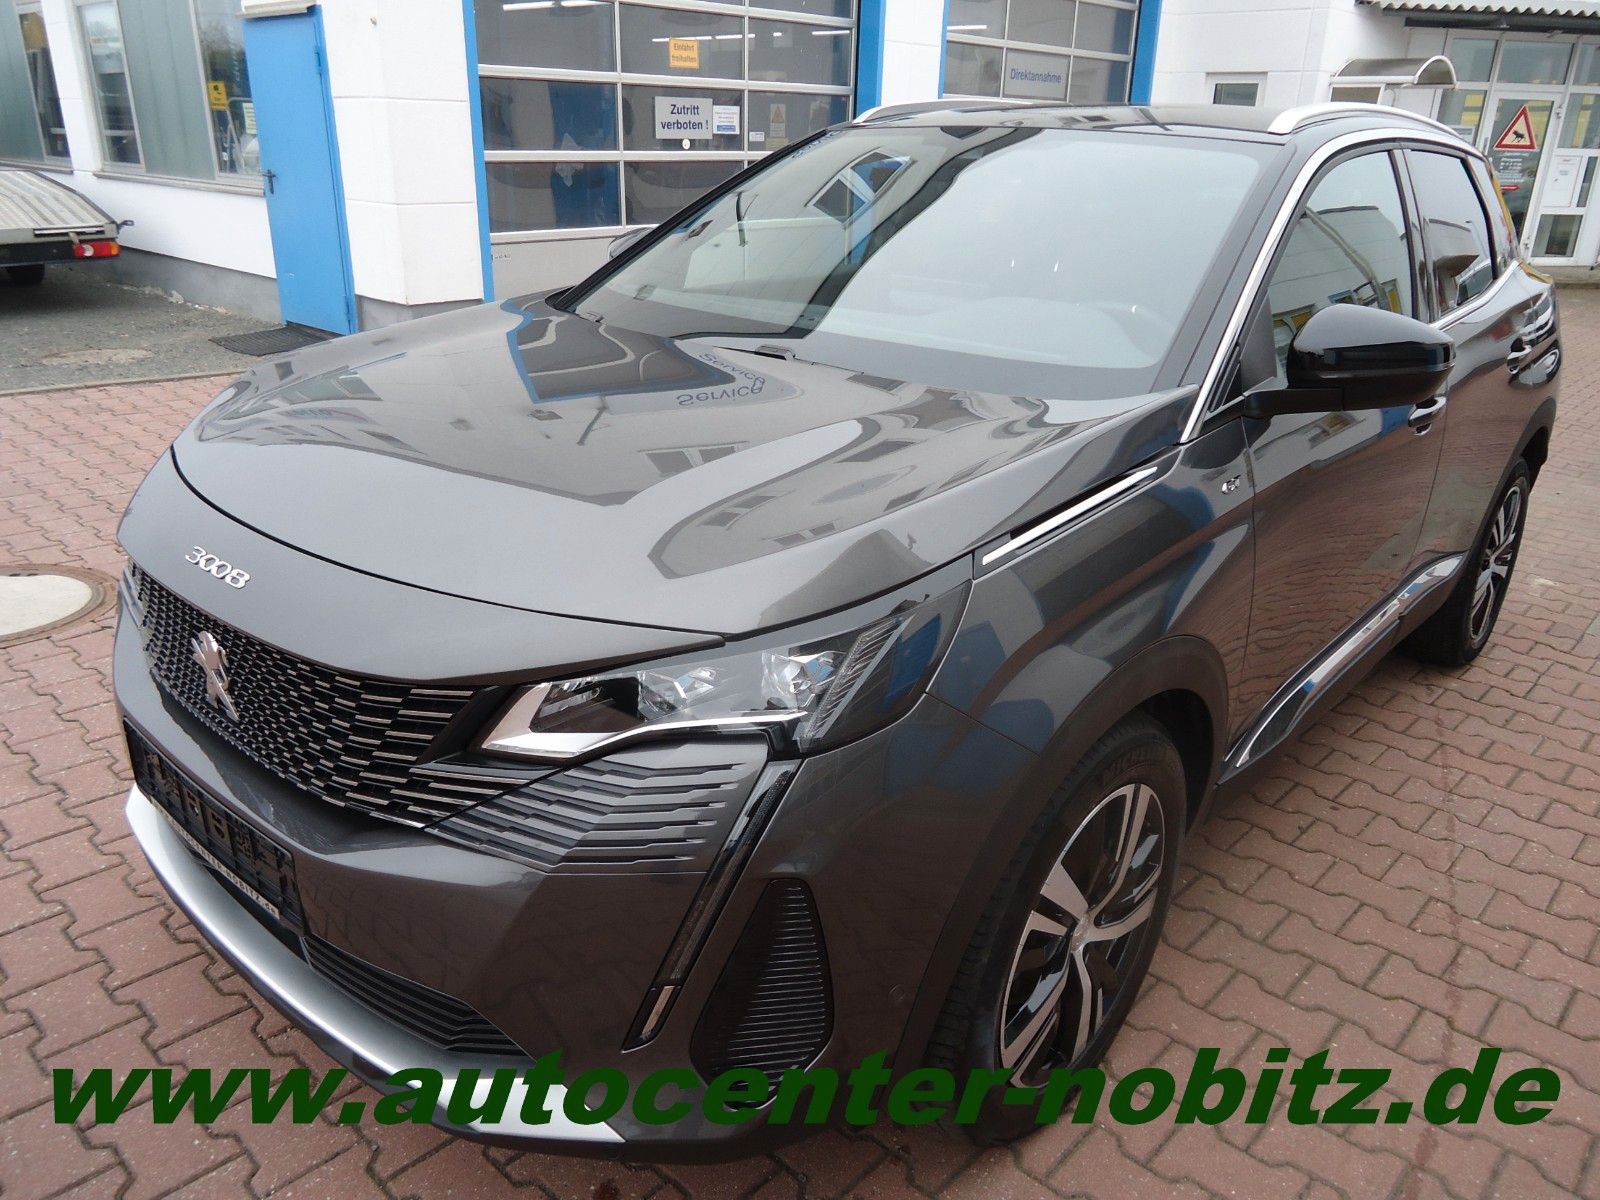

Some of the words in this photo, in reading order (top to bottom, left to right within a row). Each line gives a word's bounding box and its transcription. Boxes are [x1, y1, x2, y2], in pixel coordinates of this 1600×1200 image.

[1010, 68, 1062, 83] Direktannahme
[670, 103, 700, 116] Zutritt
[660, 119, 703, 130] verboten
[185, 545, 251, 589] 3008
